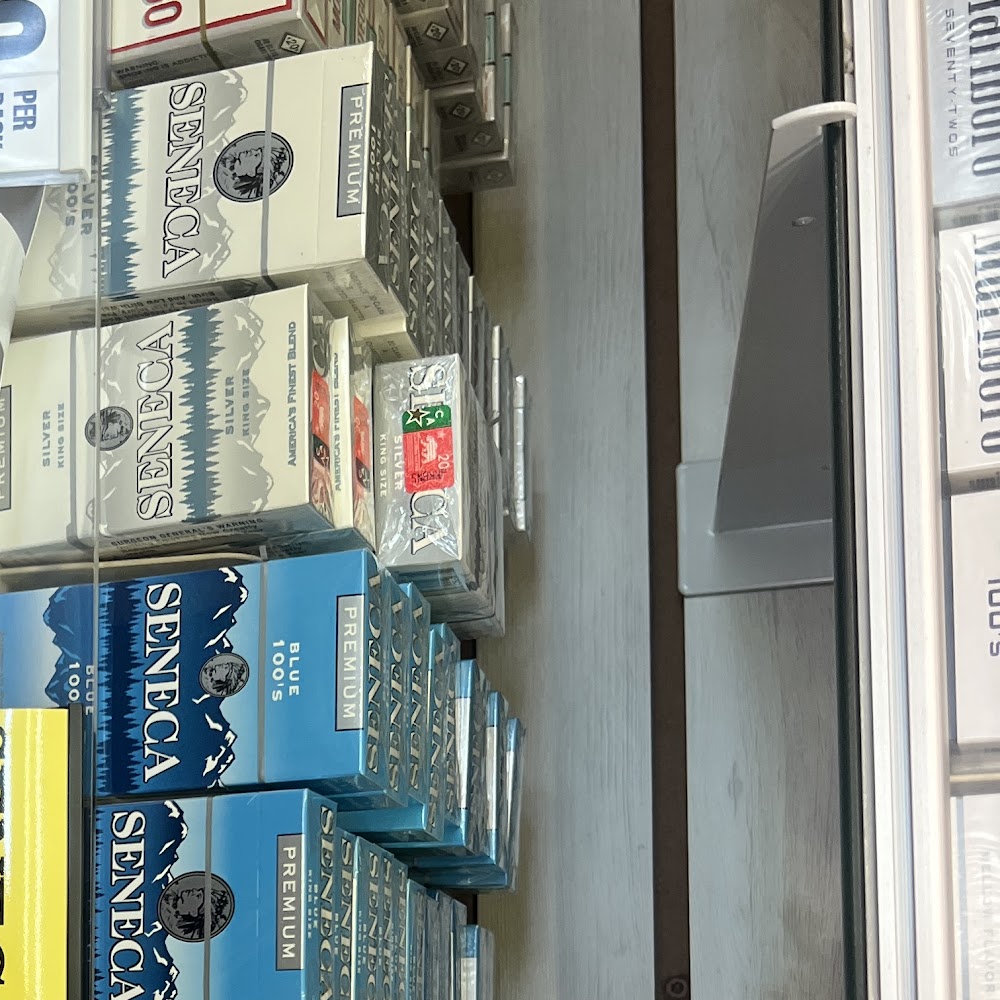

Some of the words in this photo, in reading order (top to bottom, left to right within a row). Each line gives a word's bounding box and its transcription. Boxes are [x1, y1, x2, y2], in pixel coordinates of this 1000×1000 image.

[12, 90, 37, 130] PER
[945, 8, 958, 158] SEVENTY-TWOS
[162, 81, 206, 279] SENECA
[347, 96, 362, 204] PREMIUM
[288, 322, 296, 360] BLEND
[225, 377, 234, 435] SILVER
[287, 364, 296, 403] FINEST
[42, 410, 51, 467] SILVER
[136, 321, 173, 521] SENECA
[287, 407, 296, 467] AMERICA'S
[379, 434, 387, 465] KING
[143, 582, 182, 783] SENECA
[272, 639, 285, 702] 100'S
[289, 642, 299, 696] BLUE
[342, 606, 357, 718] PREMIUM
[282, 846, 297, 959] PREMIUM
